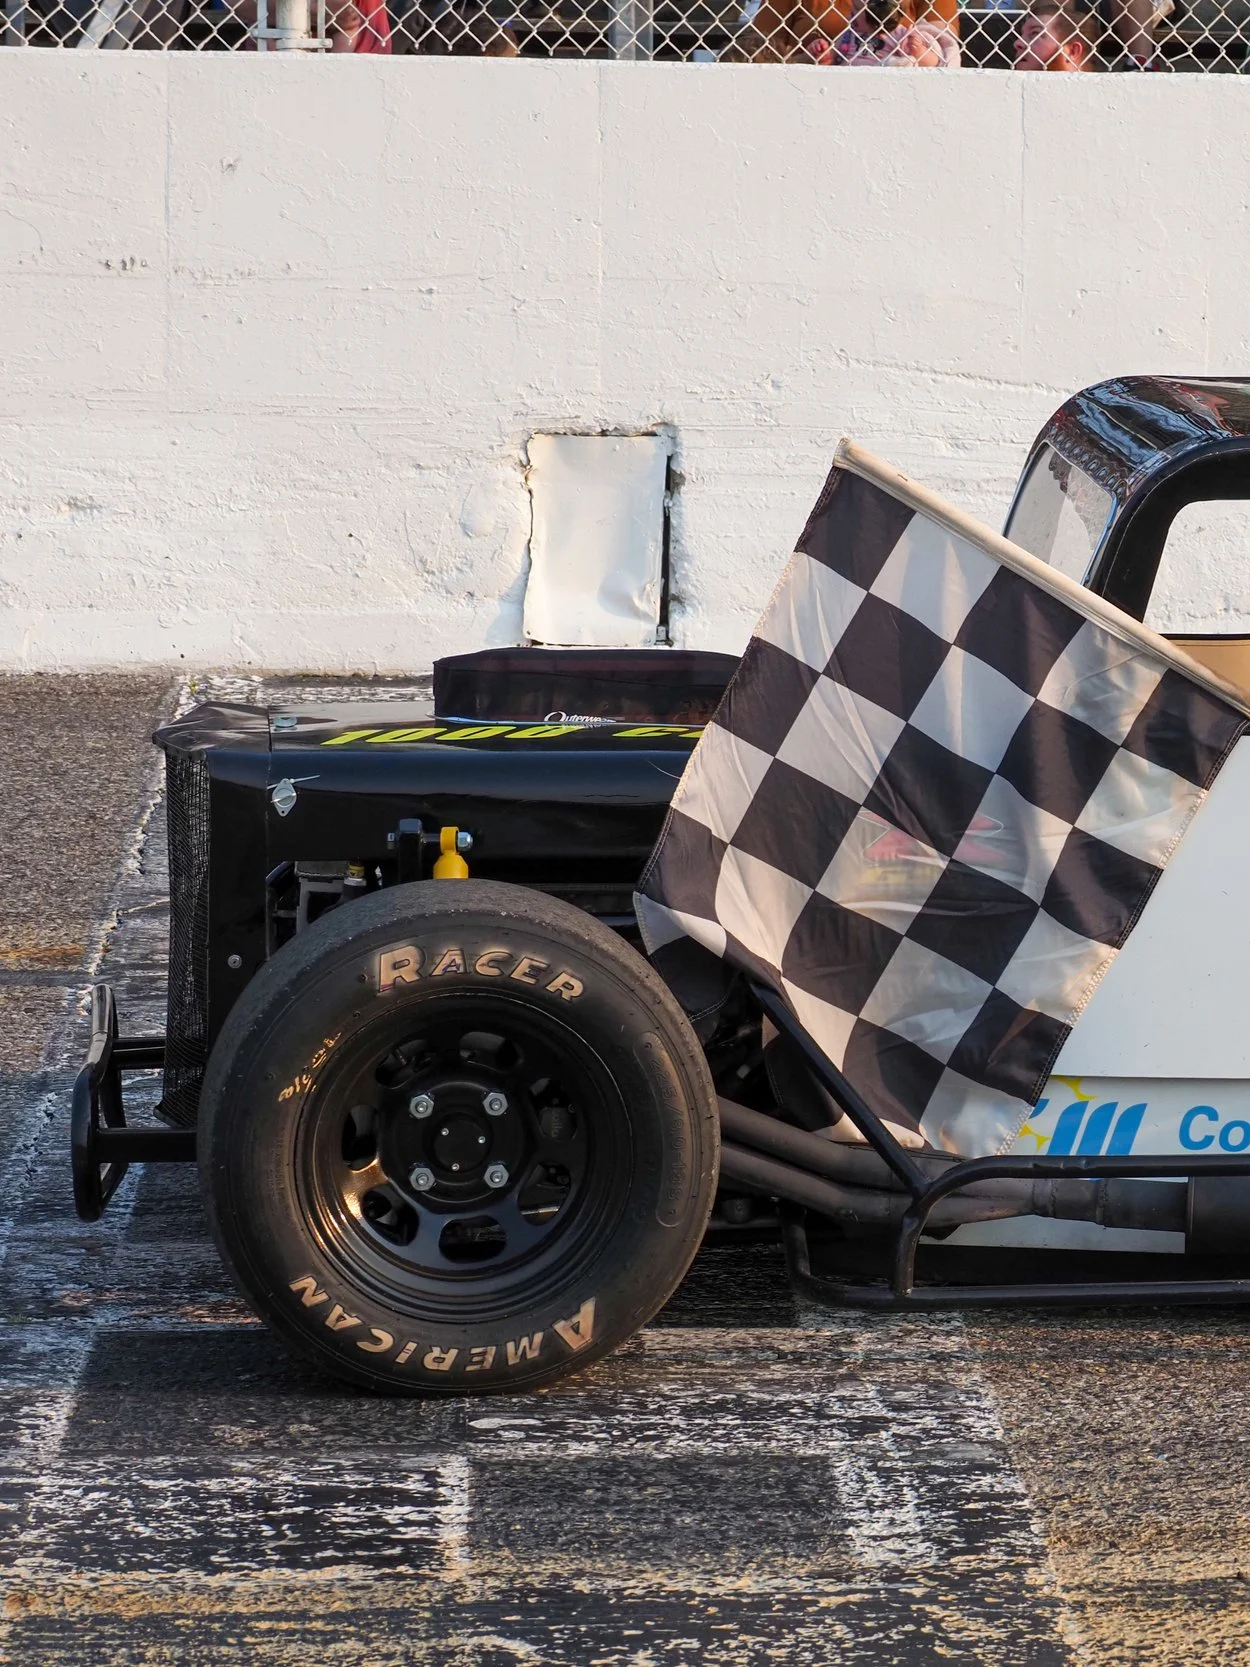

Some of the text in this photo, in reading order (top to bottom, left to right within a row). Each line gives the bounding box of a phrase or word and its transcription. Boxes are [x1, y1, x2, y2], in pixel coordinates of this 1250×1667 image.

[319, 726, 582, 746] 1000
[377, 943, 586, 1002] RACER
[288, 1274, 598, 1373] AMERICAN
